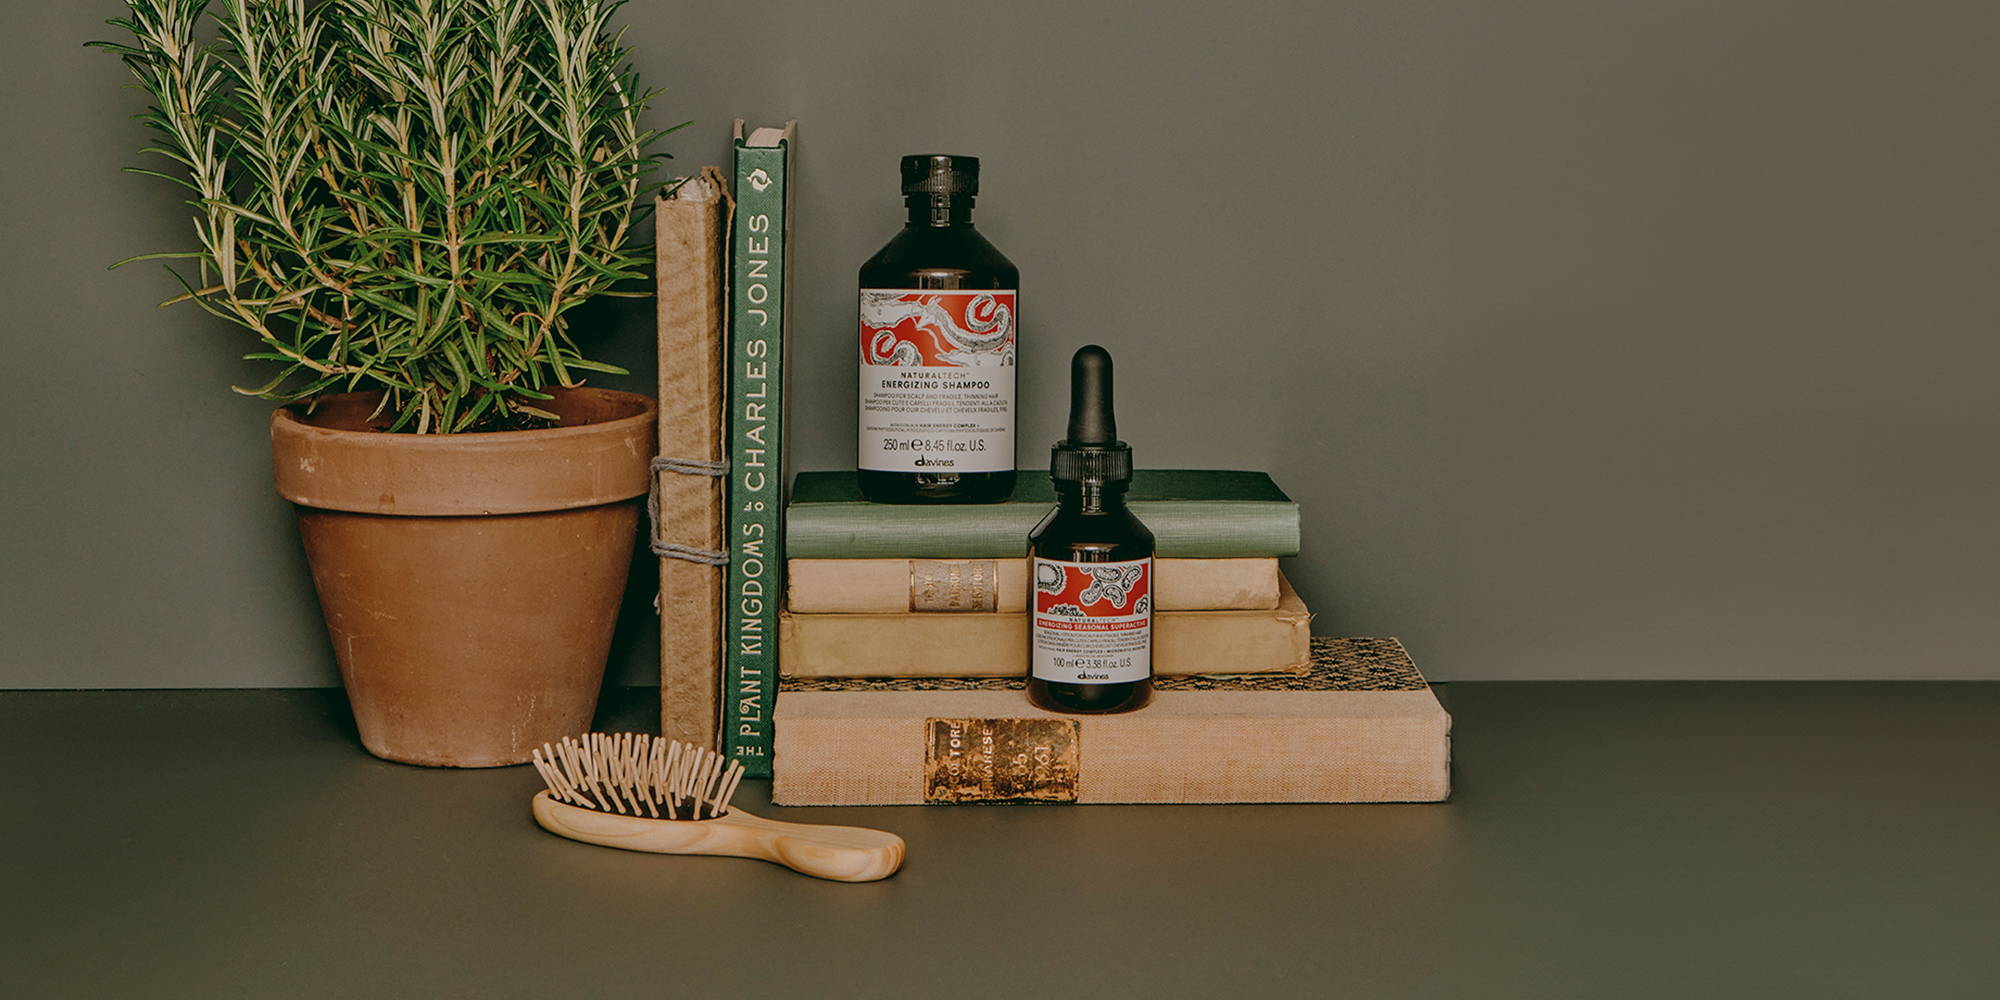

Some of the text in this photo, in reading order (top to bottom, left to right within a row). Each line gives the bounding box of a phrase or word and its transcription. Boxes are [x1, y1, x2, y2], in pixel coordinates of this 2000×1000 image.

[881, 380, 991, 390] ENERGIZING SHAMPOO
[883, 438, 898, 451] 250
[899, 439, 910, 451] ml
[914, 454, 955, 467] davines
[736, 214, 769, 756] THE PLANT KINGDOMS OF CHARLES JONES
[1038, 619, 1073, 629] ENERGIZING
[1053, 657, 1065, 667] 100
[1077, 670, 1109, 680] davines
